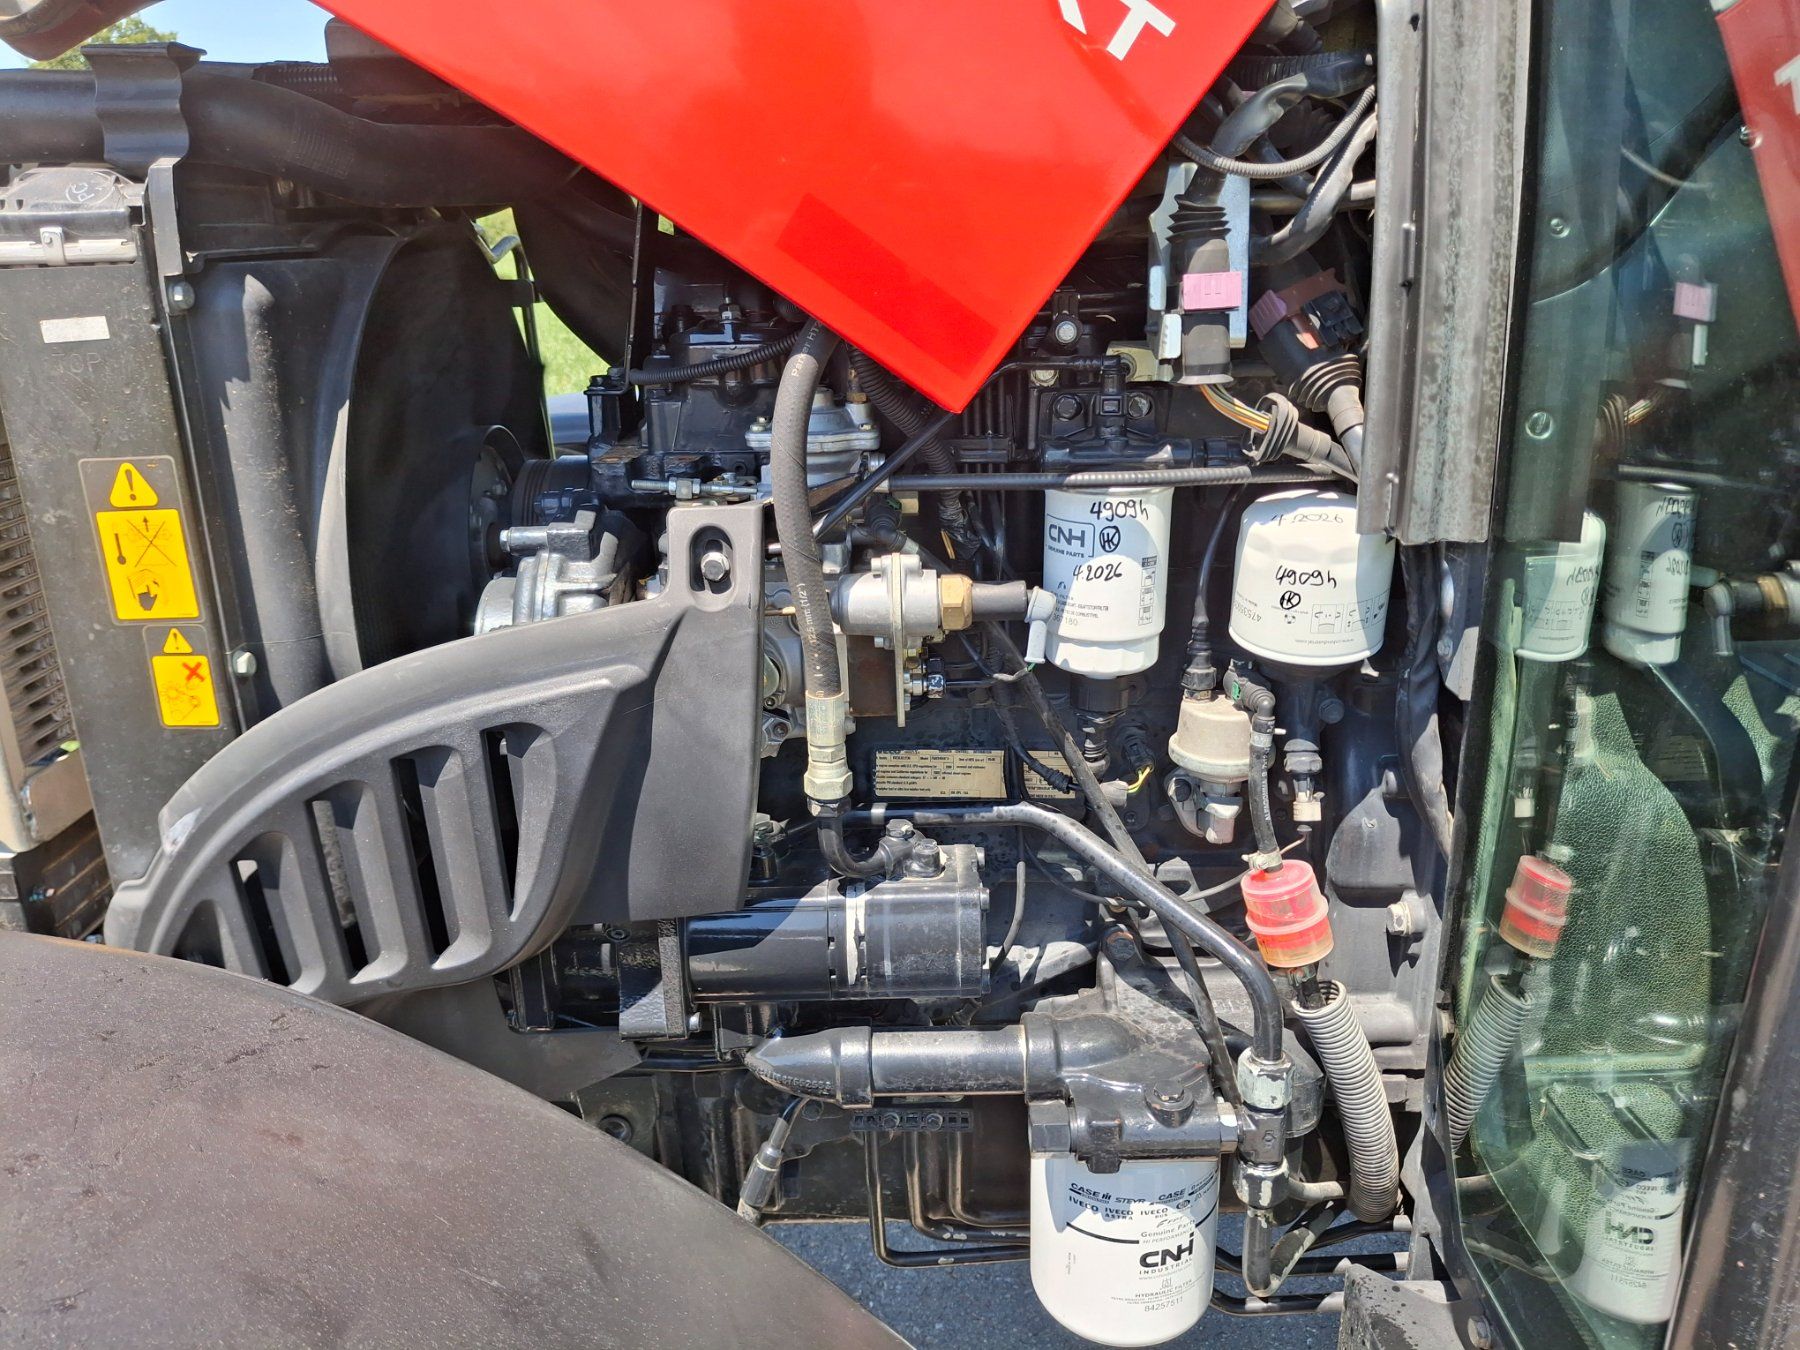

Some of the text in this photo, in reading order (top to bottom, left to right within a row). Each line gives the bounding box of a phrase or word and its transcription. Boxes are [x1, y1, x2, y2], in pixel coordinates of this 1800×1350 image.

[1048, 523, 1086, 548] CNH
[1071, 1182, 1100, 1198] CASE
[1158, 1188, 1186, 1201] CASE
[1069, 1196, 1099, 1212] IVECO
[1104, 1207, 1134, 1216] IVECO
[1140, 1207, 1169, 1216] IVECO
[1141, 1228, 1174, 1238] Genuine
[1139, 1232, 1195, 1268] CNH
[1139, 1257, 1193, 1275] INDUSTRIAL
[1135, 1288, 1174, 1298] HYDRAULIC
